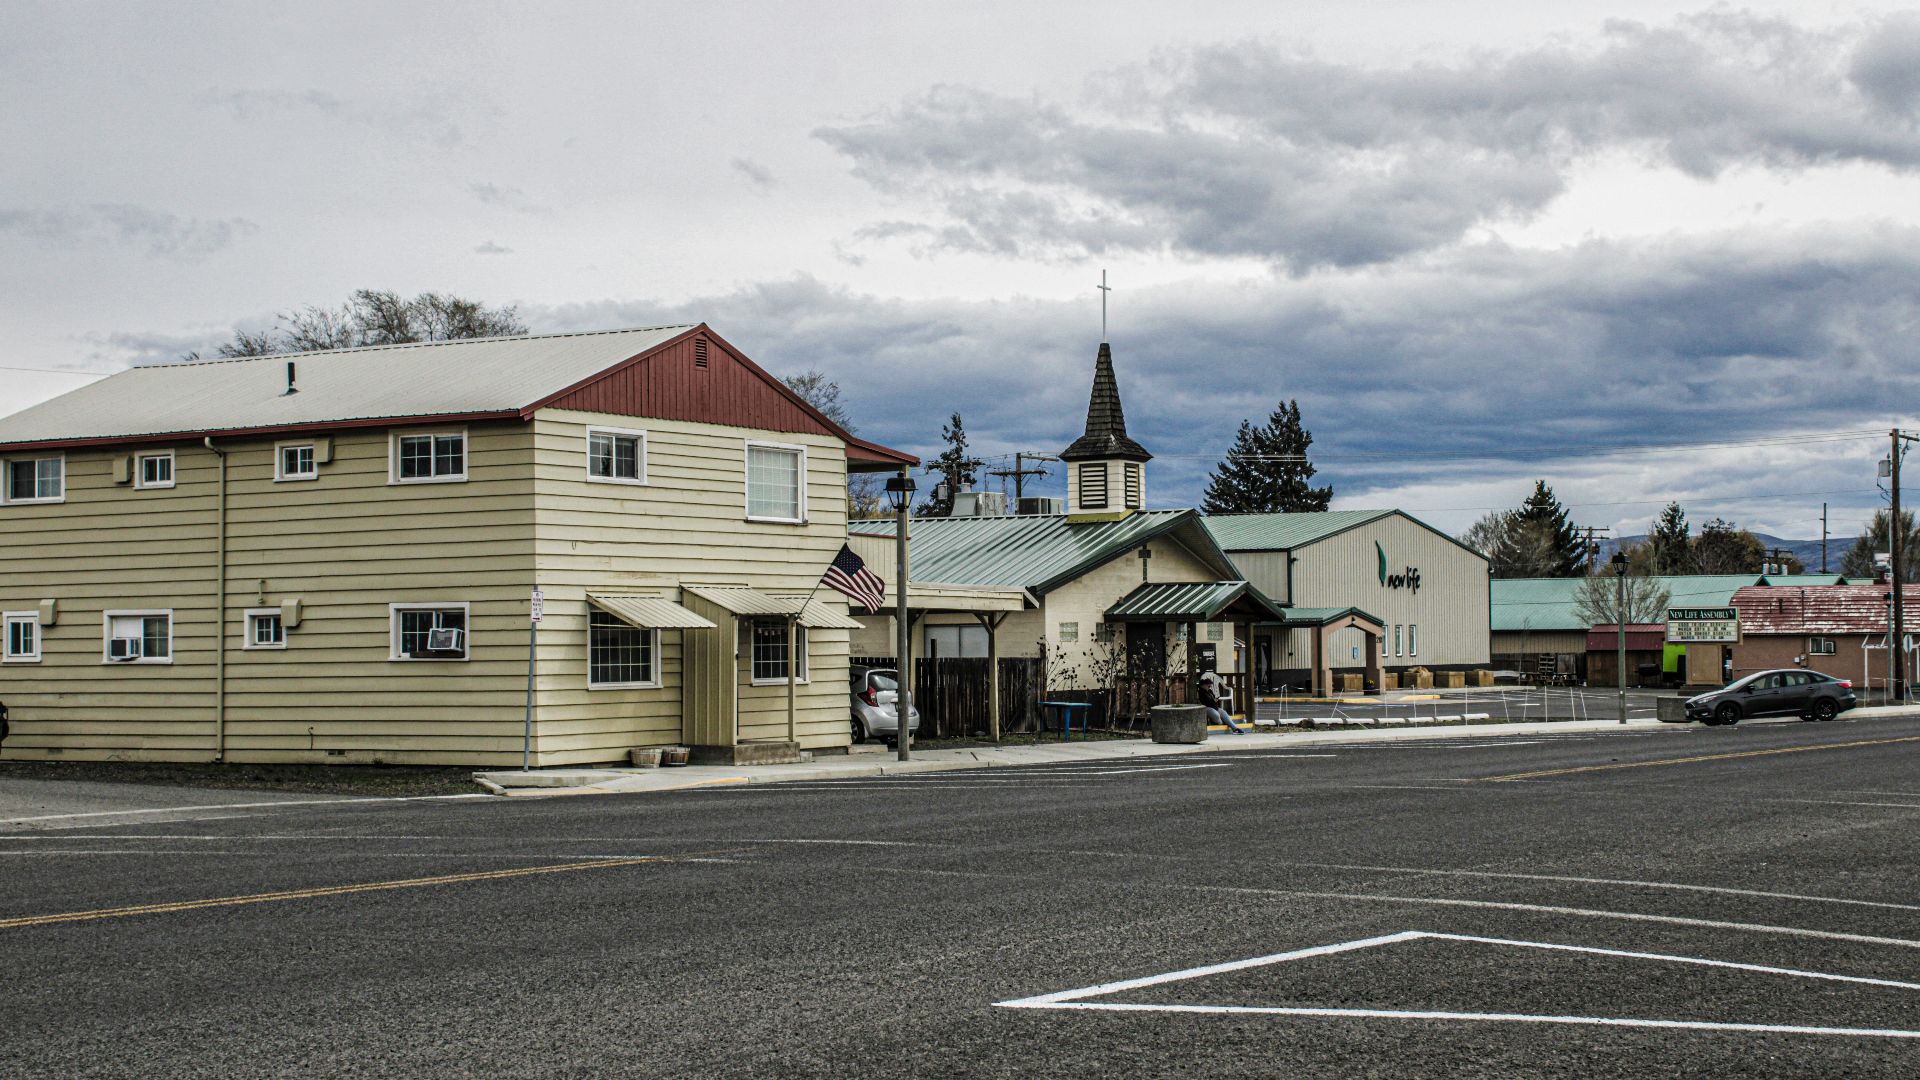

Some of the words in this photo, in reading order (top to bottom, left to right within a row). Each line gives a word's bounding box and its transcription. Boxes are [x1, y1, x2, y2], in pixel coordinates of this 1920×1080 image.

[1387, 574, 1406, 590] new
[1406, 566, 1420, 595] life
[1669, 610, 1683, 618] NEW
[1684, 610, 1698, 618] LIFE
[1699, 610, 1729, 618] ASSEMBLY
